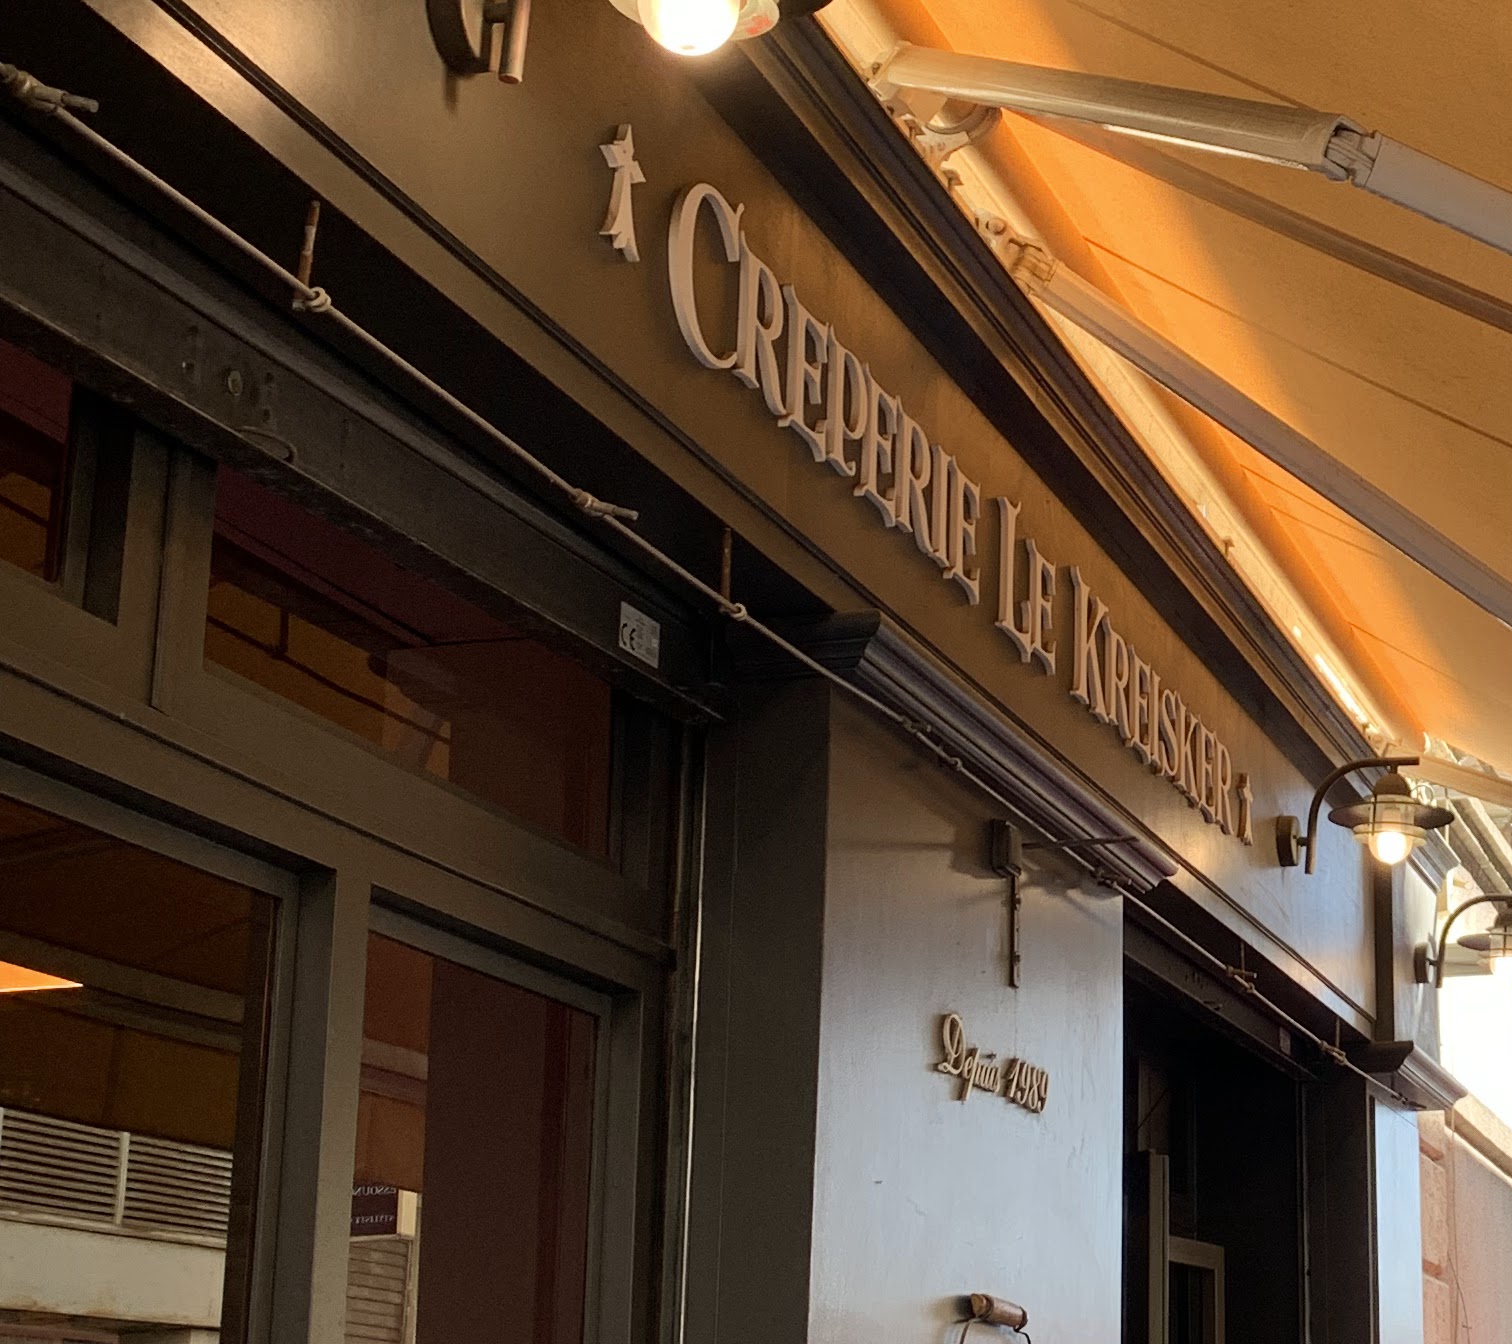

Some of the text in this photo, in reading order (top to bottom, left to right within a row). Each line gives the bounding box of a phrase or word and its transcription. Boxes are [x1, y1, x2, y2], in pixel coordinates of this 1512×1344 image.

[667, 182, 1237, 837] CREPERIE LE KREISKER
[937, 1013, 1000, 1102] Depuis
